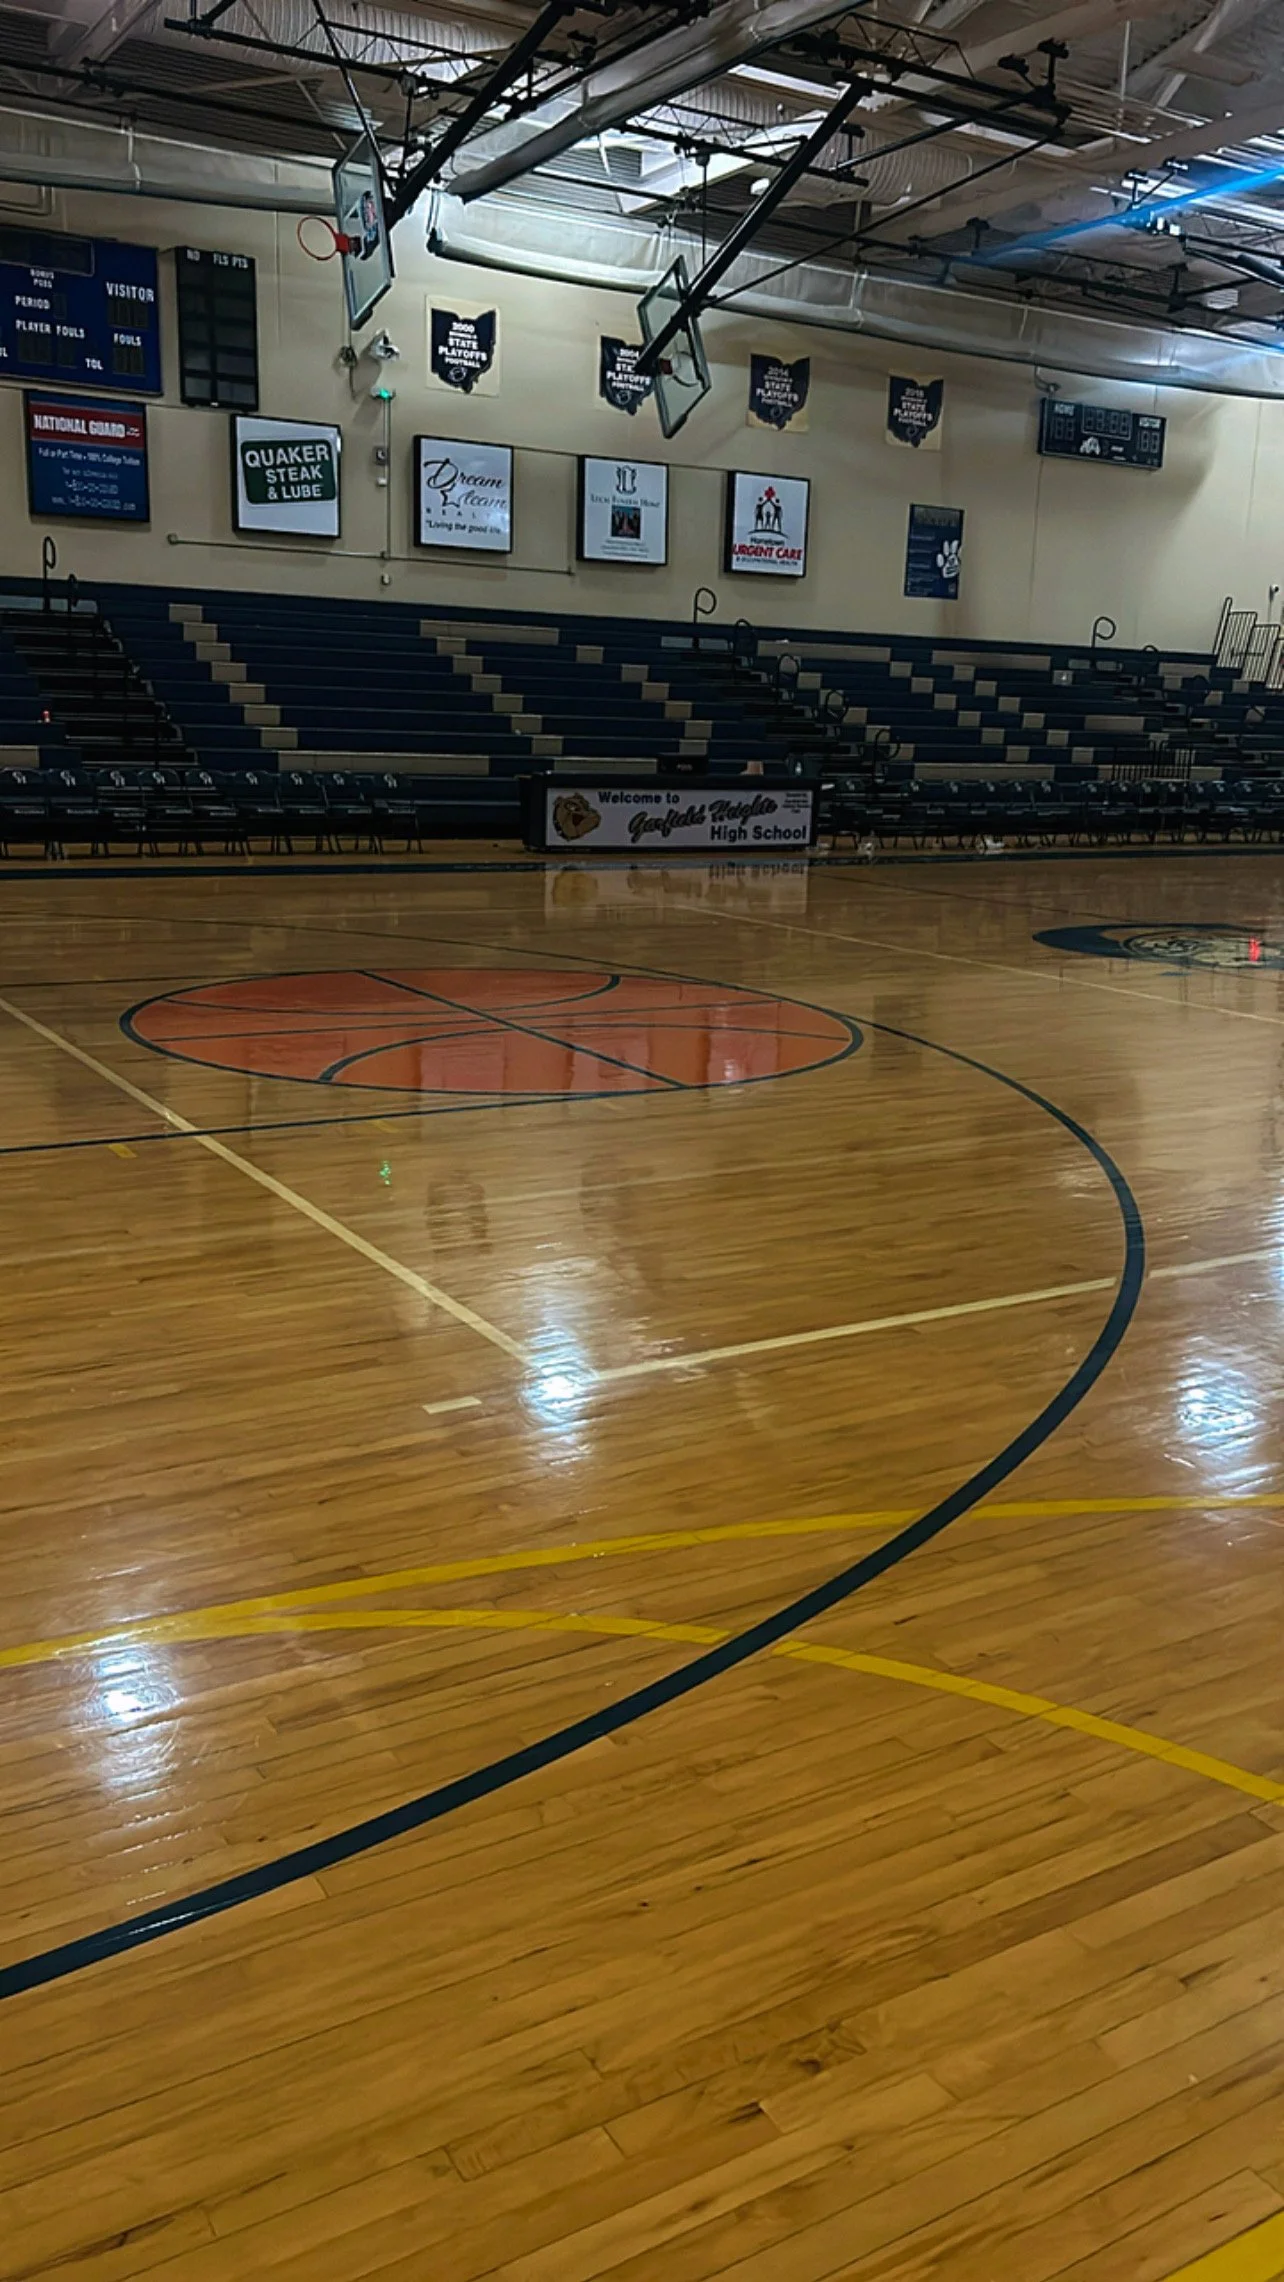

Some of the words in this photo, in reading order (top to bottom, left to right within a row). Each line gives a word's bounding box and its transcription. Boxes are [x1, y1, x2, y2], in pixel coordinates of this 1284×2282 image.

[213, 253, 229, 266] FLS
[232, 256, 248, 269] PTS
[30, 269, 54, 279] BONUS
[106, 282, 154, 302] VISITOR
[15, 295, 50, 310] PERIOD
[15, 319, 51, 334] PLAYER
[56, 325, 85, 339] FOULS
[113, 333, 142, 347] FOULS
[448, 337, 479, 350] STATE
[438, 345, 488, 362] PLAYOFFS
[85, 358, 104, 370] TOL
[444, 357, 481, 368] FOOTBALL
[606, 370, 651, 386] PLAYOFFS
[764, 381, 791, 392] STATE
[756, 388, 799, 402] PLAYOFFS
[902, 401, 926, 411] STATE
[893, 407, 933, 421] PLAYOFFS
[33, 414, 88, 434] NATIONAL
[88, 420, 126, 438] GUARD
[245, 443, 329, 468] QUAKER
[265, 464, 323, 484] STEAK
[423, 457, 504, 489] Dream
[267, 486, 278, 500] &
[281, 484, 322, 499] LUBE
[454, 522, 467, 531] the
[468, 524, 488, 533] good
[750, 537, 785, 546] Hometown
[732, 544, 775, 558] URGENT
[775, 546, 803, 560] CARE
[598, 791, 661, 804] Welcome
[666, 793, 680, 804] to
[628, 804, 706, 843] Garfield
[708, 794, 778, 825] Heights
[710, 826, 747, 842] High
[752, 825, 806, 840] School
